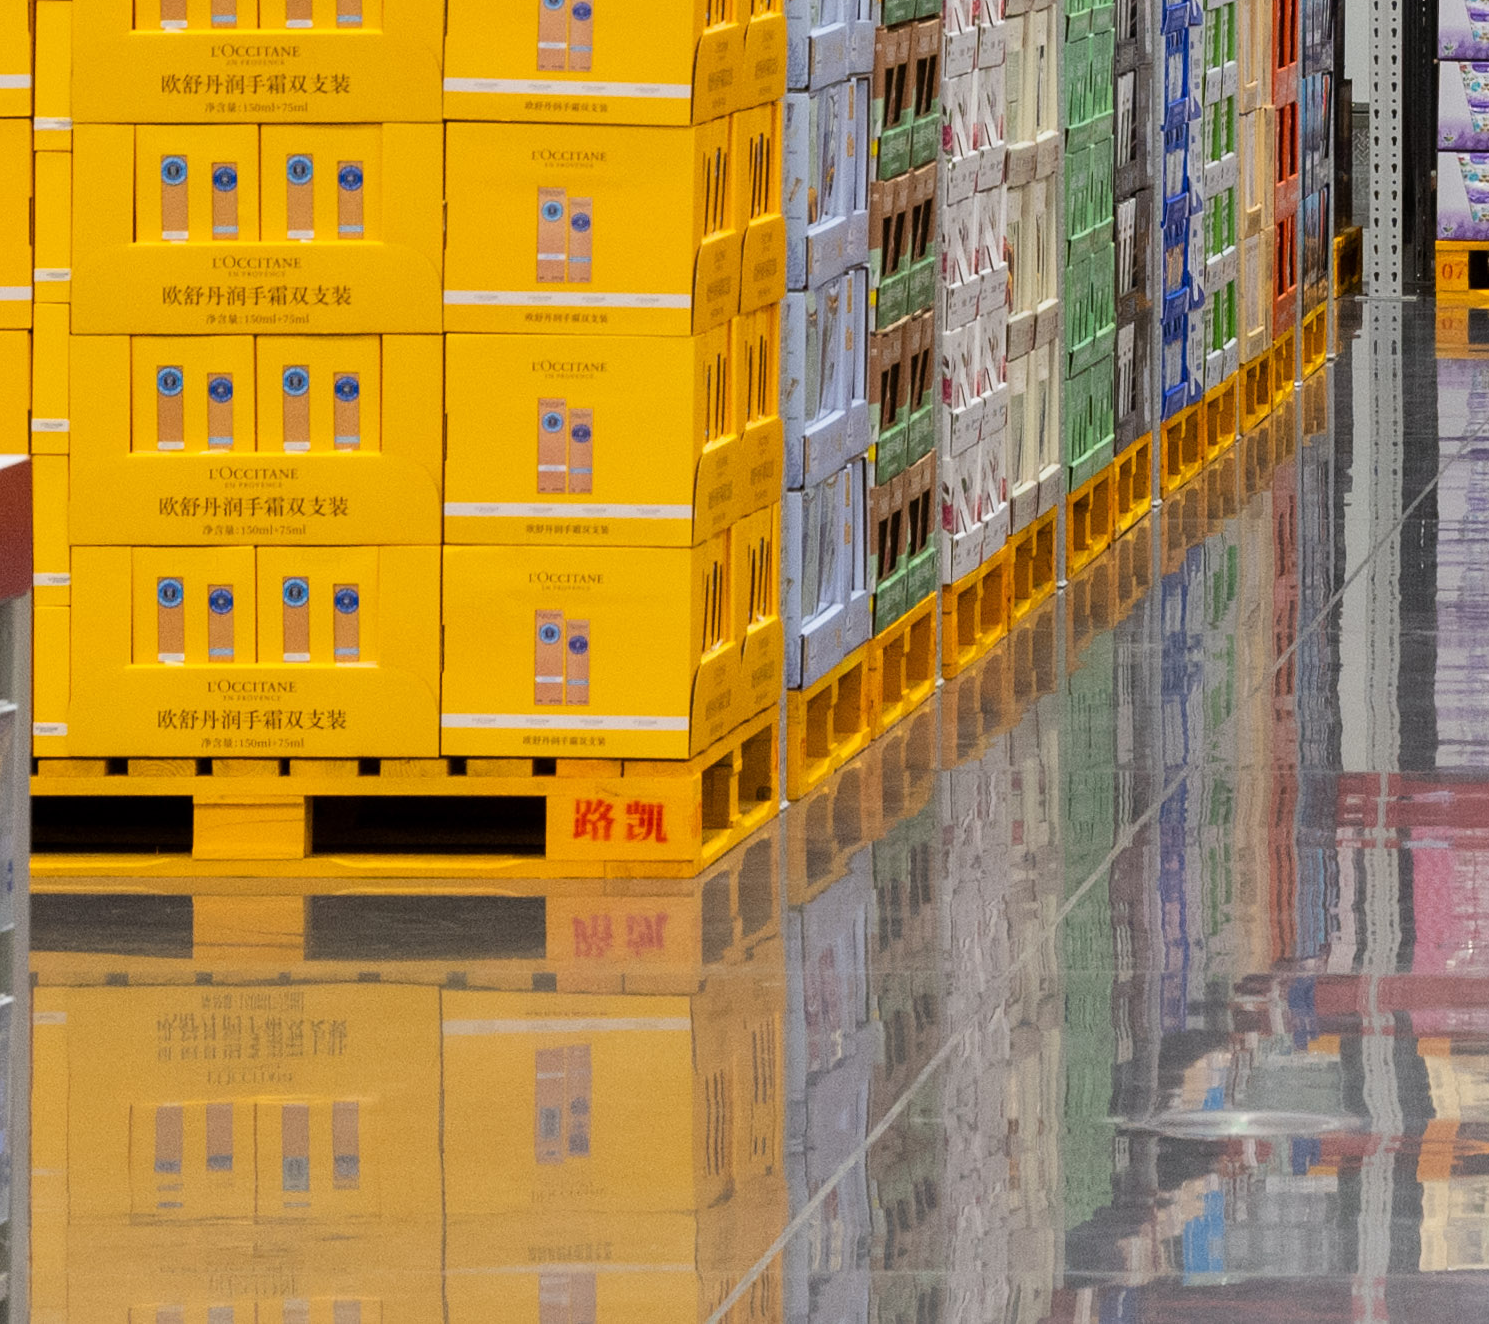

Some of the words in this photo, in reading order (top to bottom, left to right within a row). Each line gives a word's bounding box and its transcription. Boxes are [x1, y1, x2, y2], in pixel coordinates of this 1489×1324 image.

[160, 72, 351, 95] 欧舒丹润手霜双支装
[529, 571, 604, 585] L'OCCITANE
[157, 707, 347, 731] 欧舒丹润手霜双支装
[573, 798, 668, 844] 路凯
